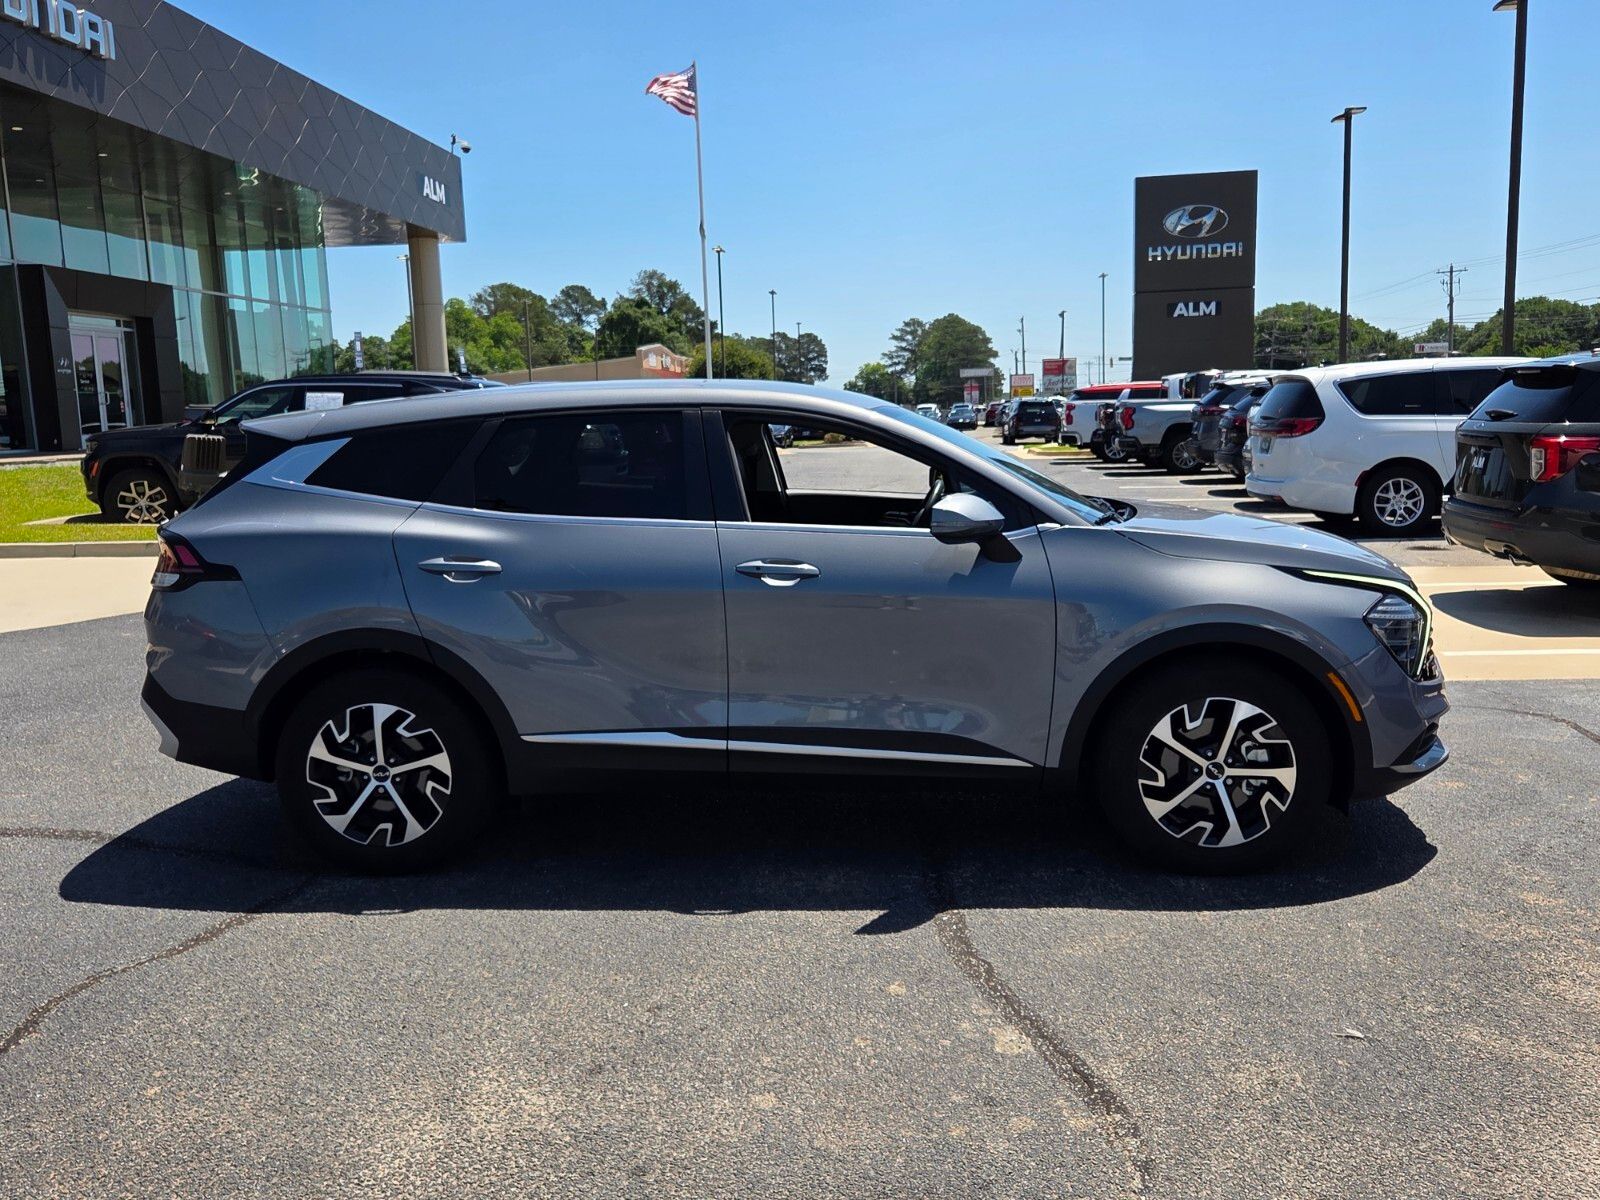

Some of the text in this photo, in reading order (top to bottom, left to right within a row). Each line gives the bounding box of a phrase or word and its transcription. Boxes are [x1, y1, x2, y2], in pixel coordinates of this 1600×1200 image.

[423, 175, 446, 205] ALM
[1147, 242, 1243, 261] HYUNDAI
[1173, 300, 1216, 318] ALM
